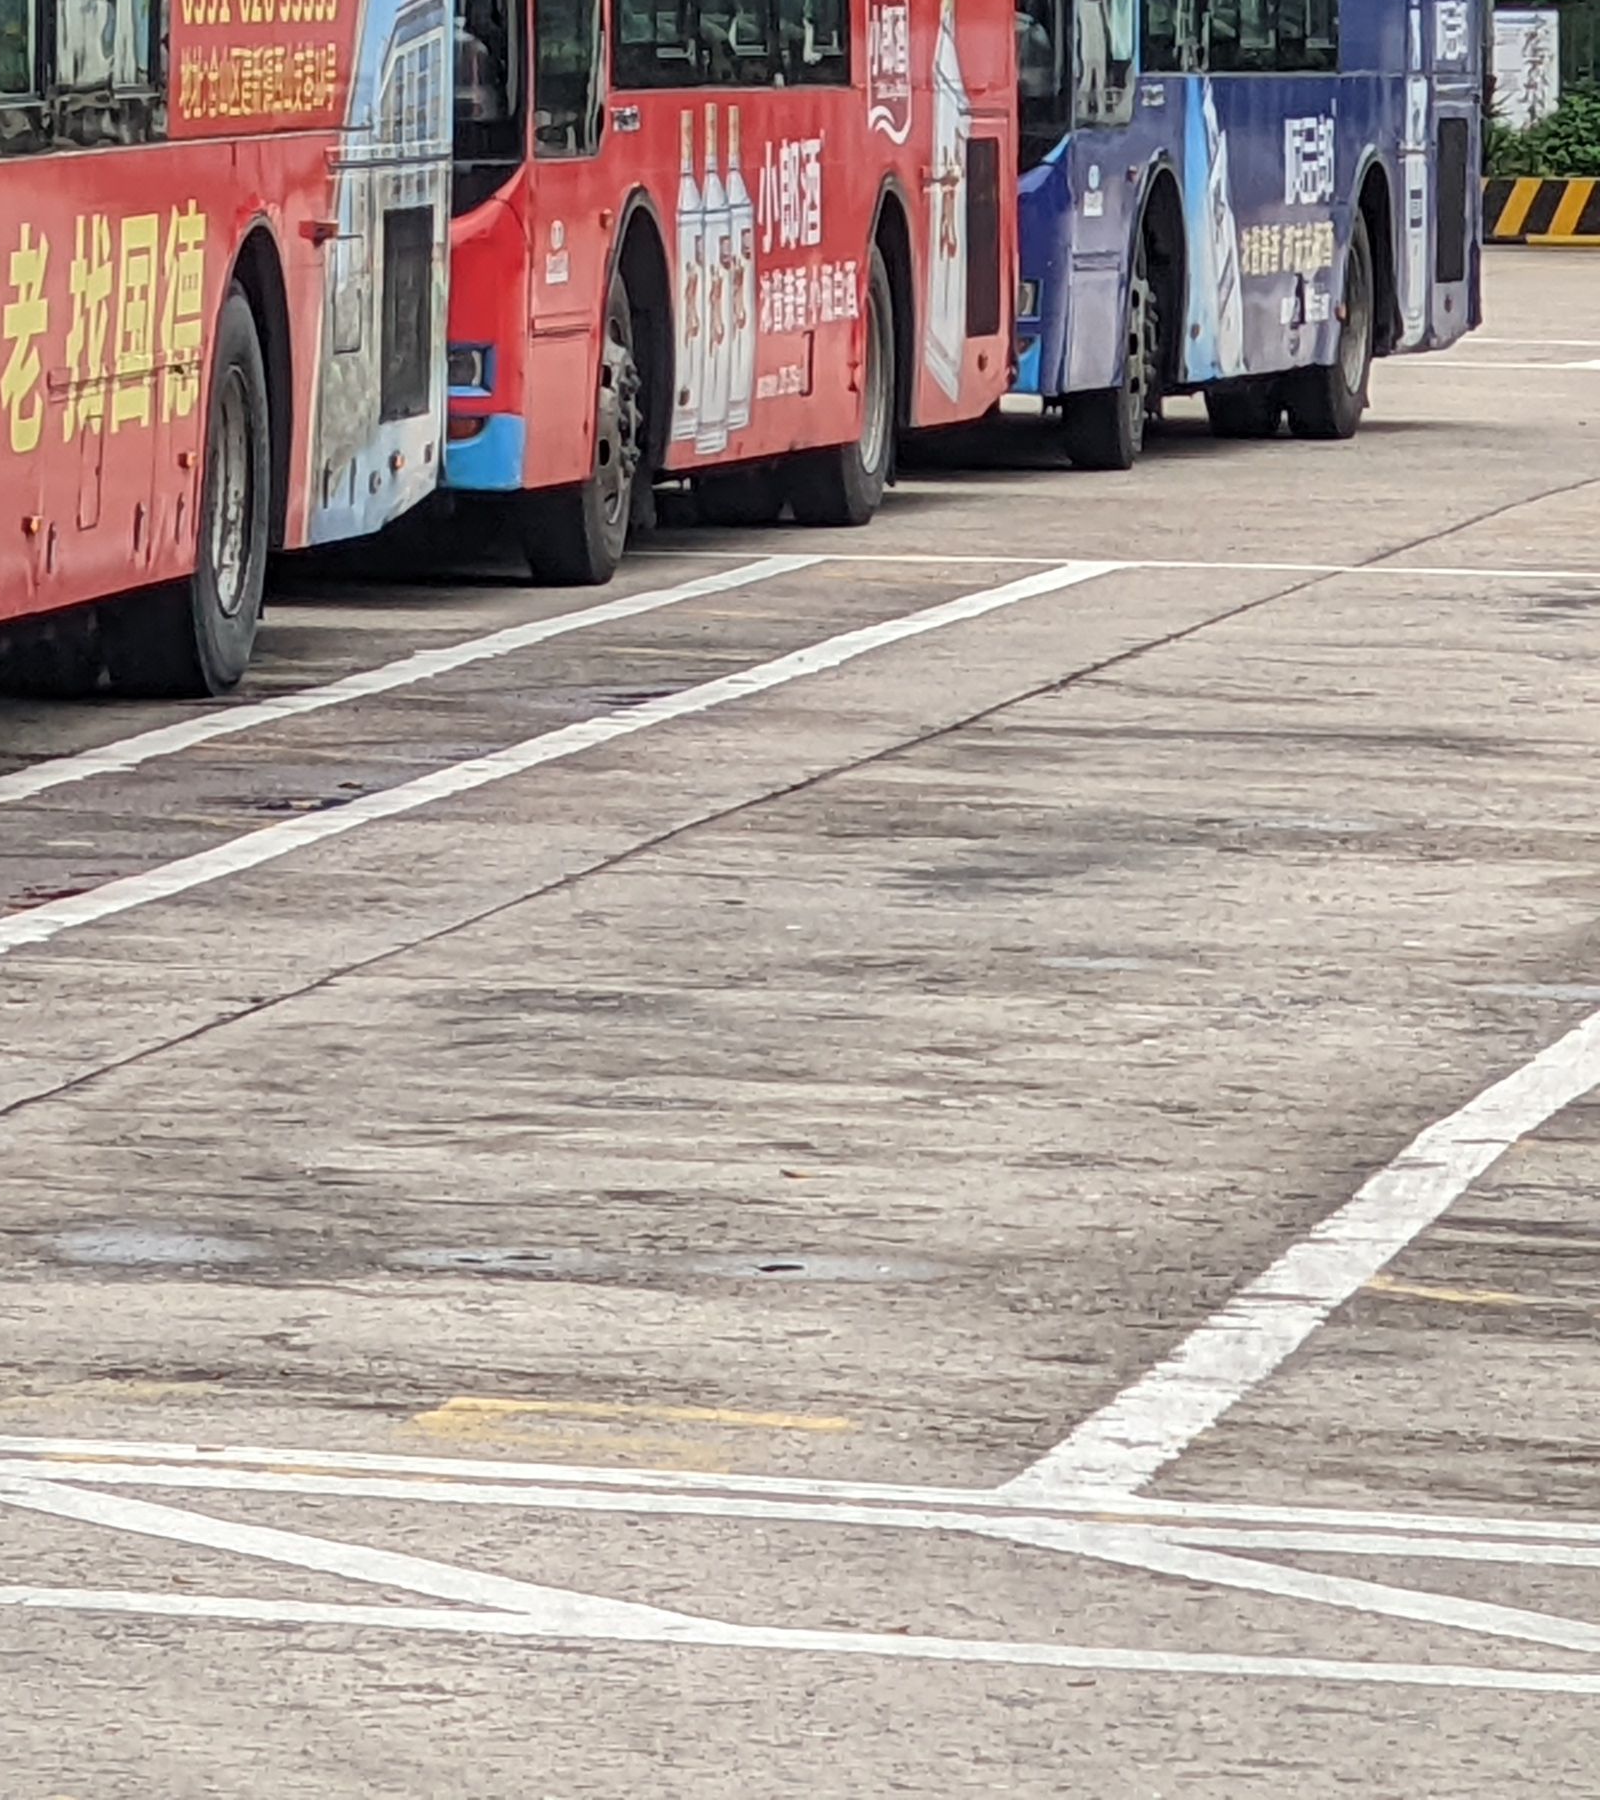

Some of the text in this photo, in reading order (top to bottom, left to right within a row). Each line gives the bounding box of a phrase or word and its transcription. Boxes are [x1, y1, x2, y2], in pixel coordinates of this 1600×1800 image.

[758, 137, 821, 254] 小郎酒
[62, 198, 207, 444] 找国德
